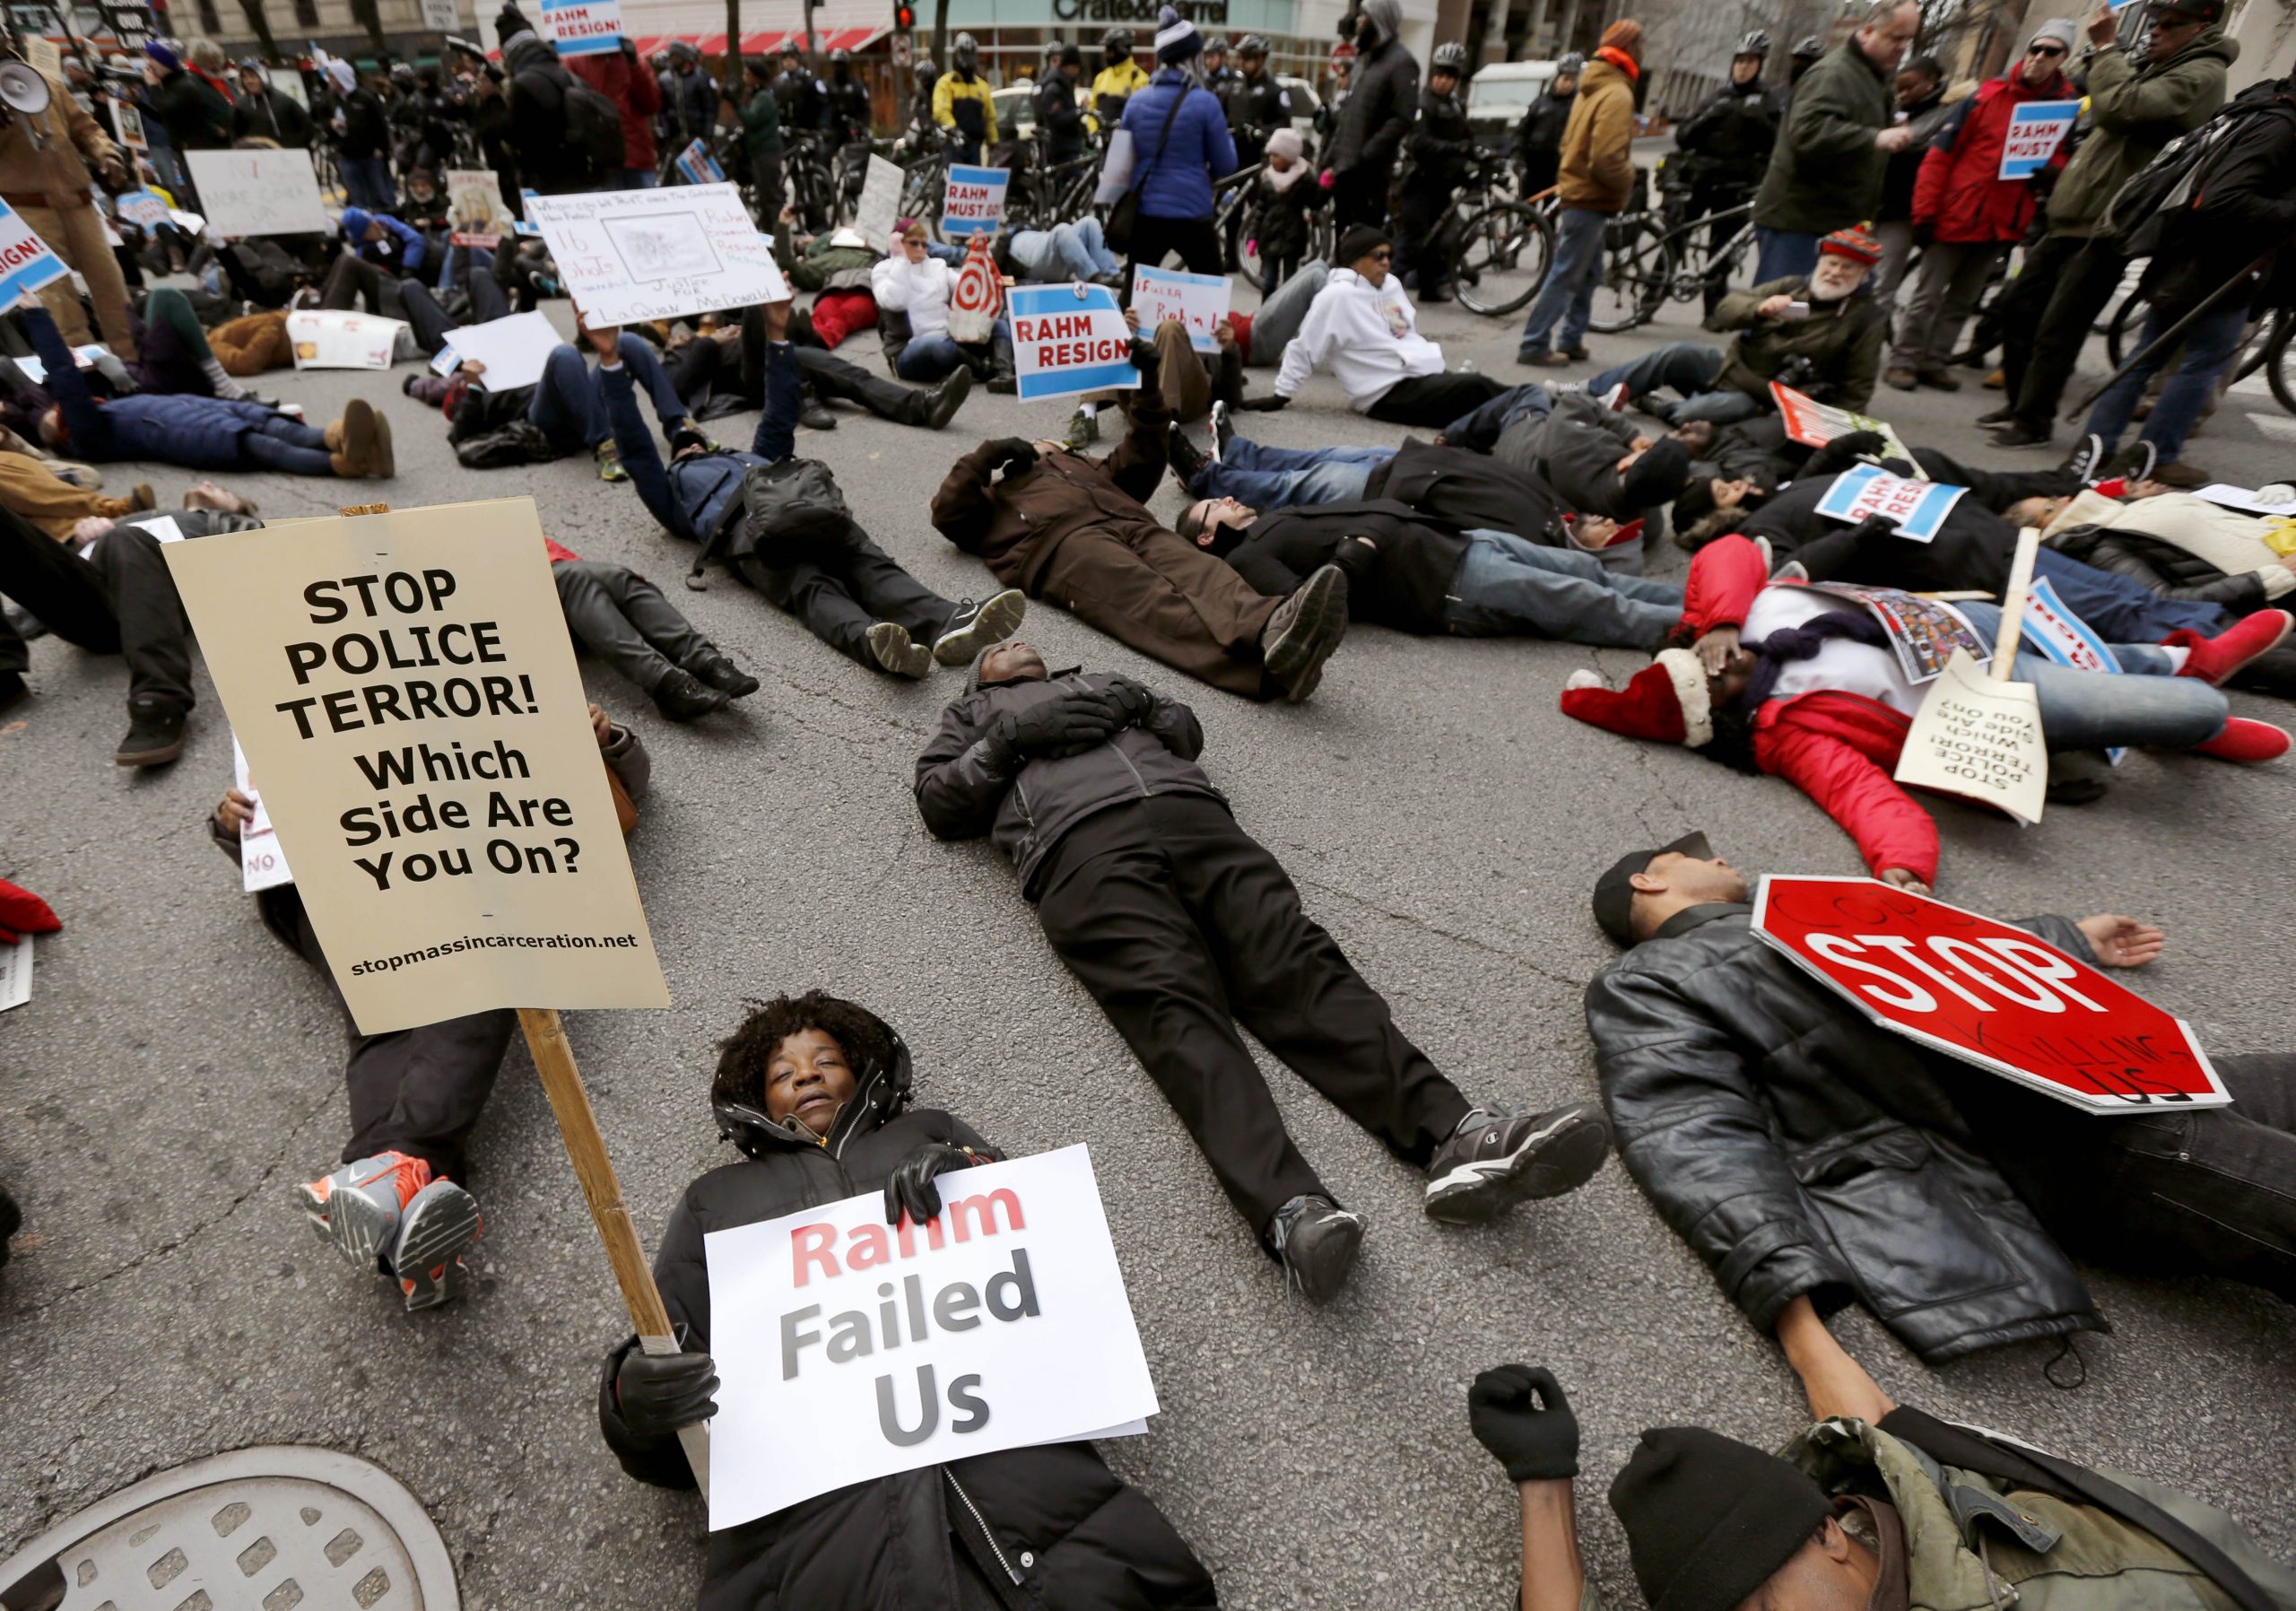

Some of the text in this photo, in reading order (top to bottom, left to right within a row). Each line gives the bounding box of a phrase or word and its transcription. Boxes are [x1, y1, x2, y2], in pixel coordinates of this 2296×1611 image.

[544, 9, 588, 24] RAHM
[558, 21, 622, 38] RESIGN!
[2012, 123, 2060, 138] RAHM
[2007, 141, 2052, 157] MUST
[946, 202, 984, 216] MUST
[949, 186, 988, 200] RAHM
[554, 228, 589, 252] 16
[1015, 315, 1091, 343] RAHM
[1039, 338, 1131, 368] RESIGN
[303, 569, 457, 624] STOP
[284, 621, 508, 685] POLICE
[274, 674, 540, 740] TERROR!
[1940, 699, 2037, 734] You On?
[1936, 709, 2034, 745] Side Are
[1946, 724, 2020, 752] Which
[352, 740, 530, 790] Which
[1930, 734, 2034, 776] TERROR!
[1935, 746, 2023, 783] POLICE
[1944, 764, 2010, 791] STOP
[340, 791, 575, 847] Side Are
[248, 854, 274, 875] NO
[352, 838, 581, 892] You On?
[352, 934, 639, 978] stopmassincarceration.net
[1805, 933, 2109, 1014] STOP
[2079, 1067, 2194, 1104] US
[779, 1248, 1041, 1381] Failed
[874, 1363, 990, 1447] Us
